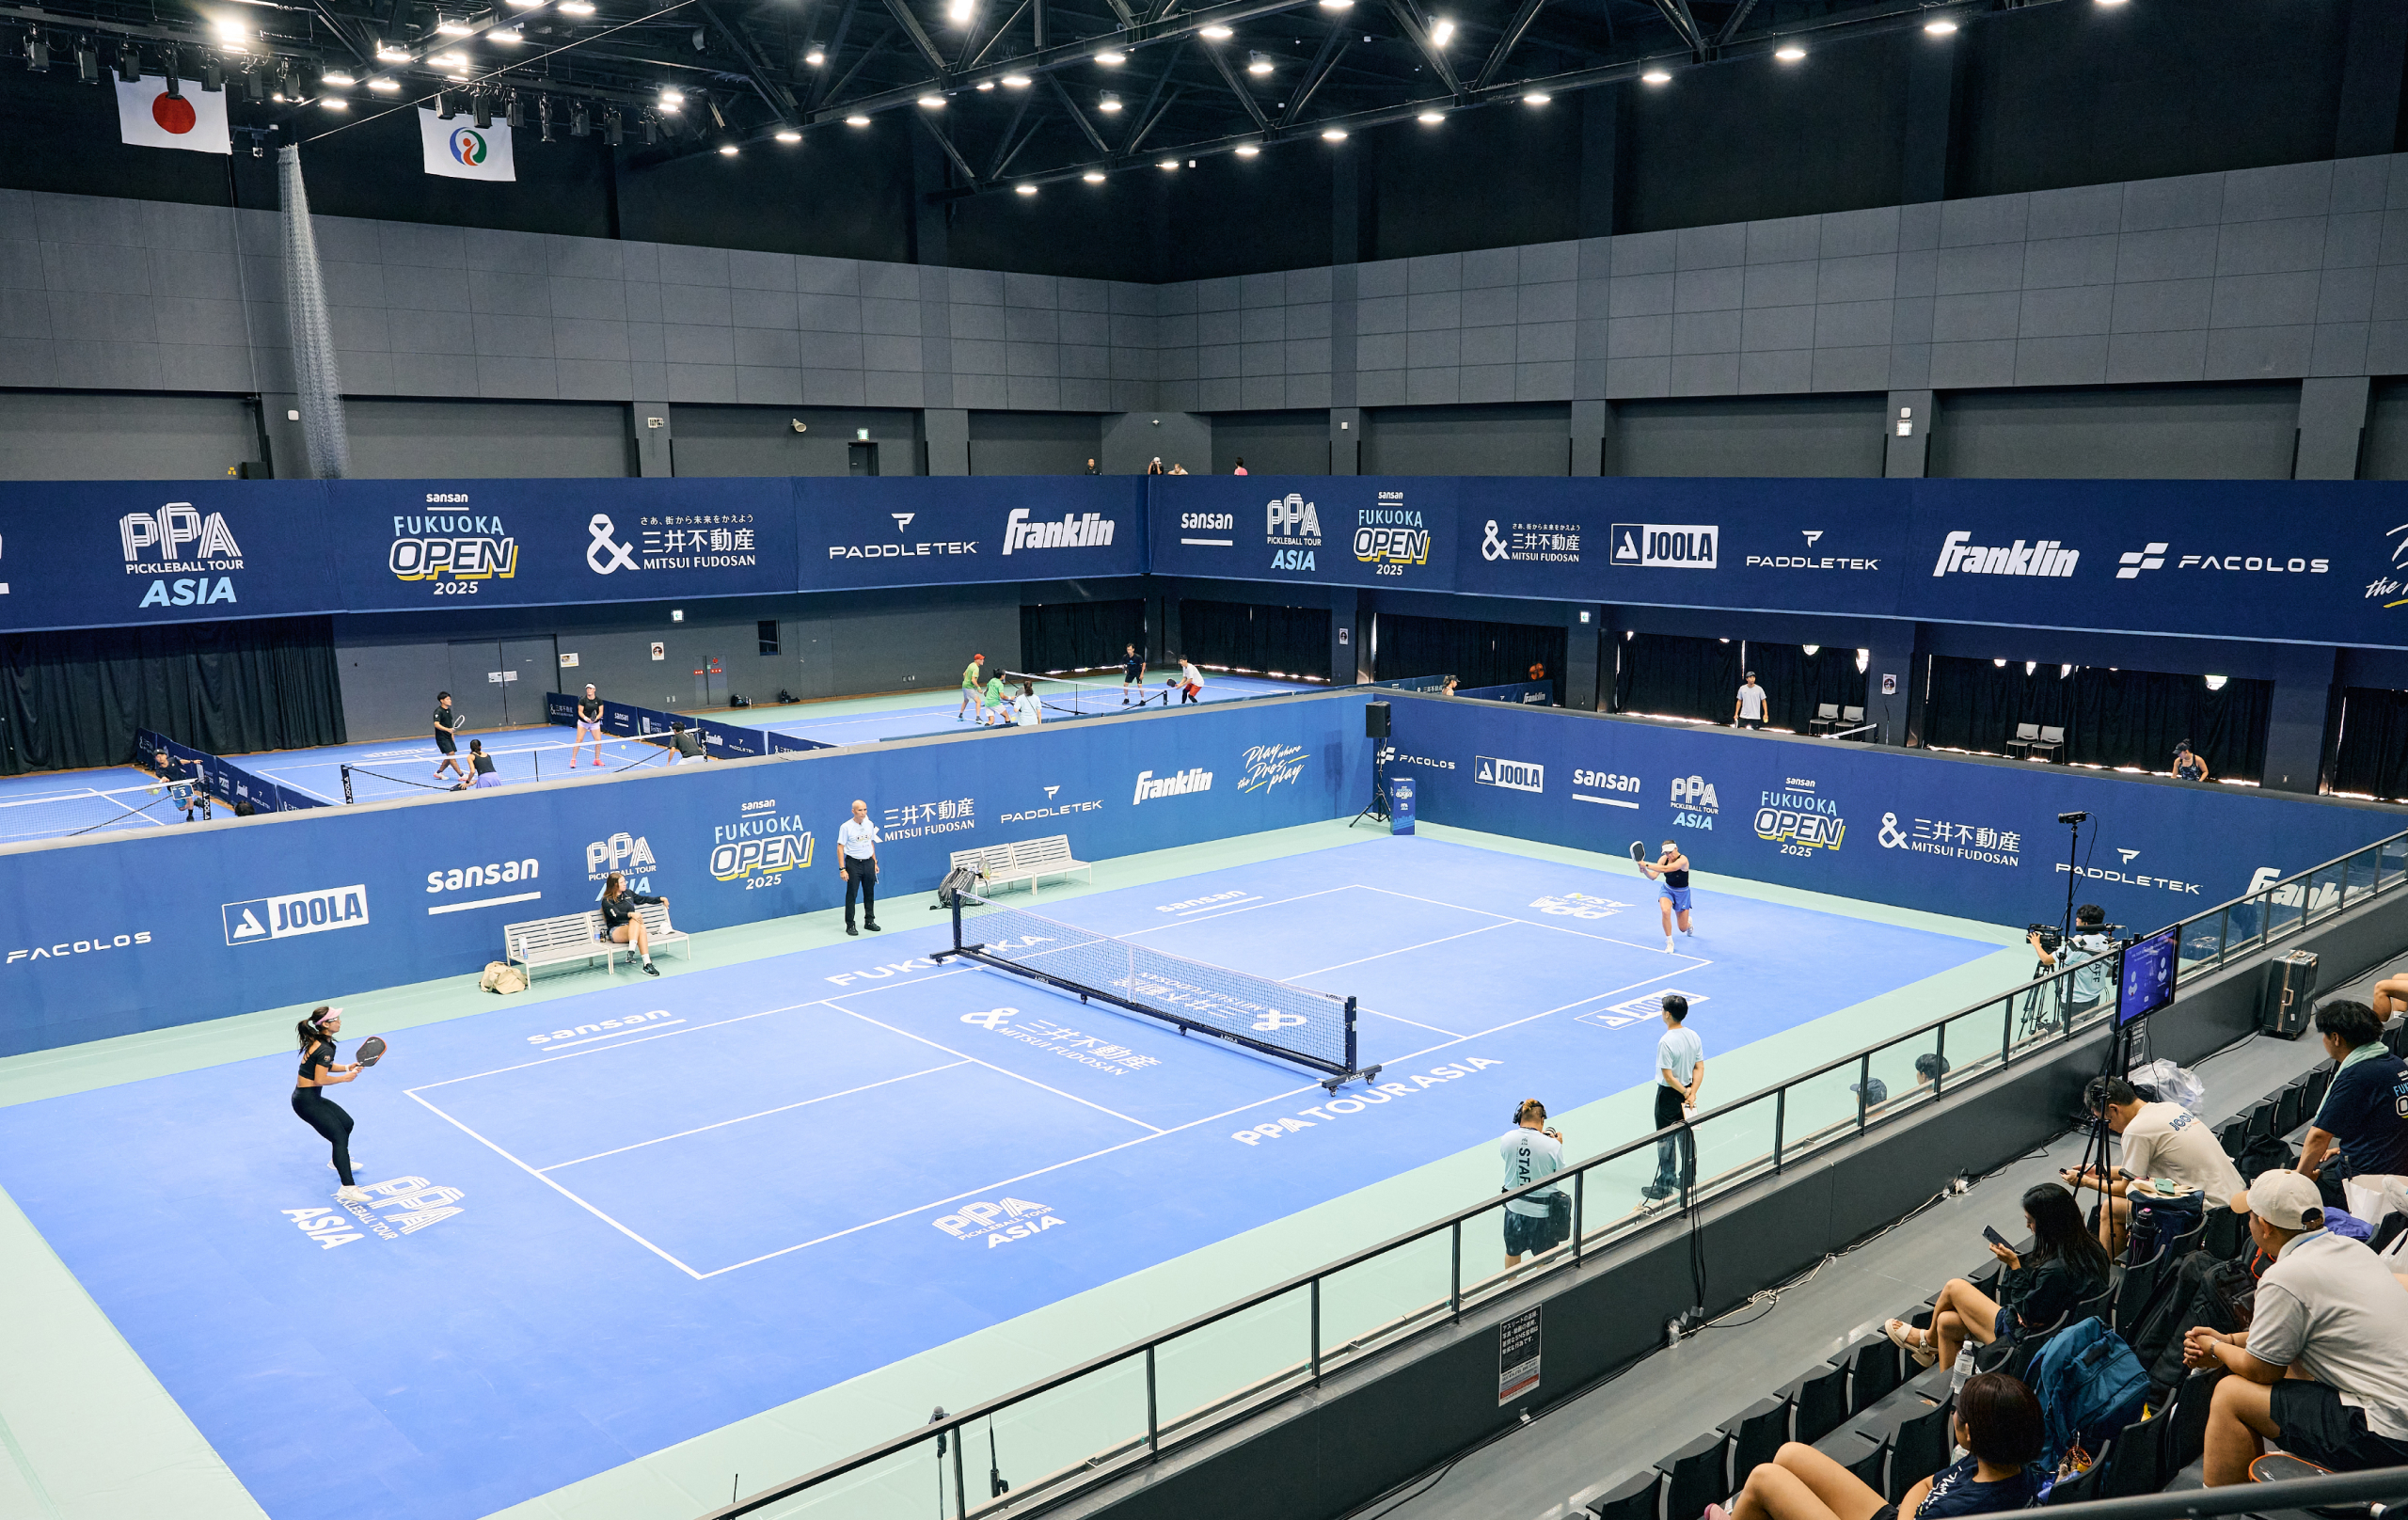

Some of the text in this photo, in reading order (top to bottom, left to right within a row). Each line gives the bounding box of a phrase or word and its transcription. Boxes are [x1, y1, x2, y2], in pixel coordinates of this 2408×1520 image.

[426, 493, 468, 503] sansan
[1378, 491, 1403, 500] sansan
[393, 515, 504, 536] FUKUOKA
[641, 515, 753, 526] さあ、街から未来をかえよう
[1180, 513, 1233, 530] sansan
[1267, 493, 1322, 536] PPA
[1358, 509, 1423, 529] FUKUOKA
[119, 502, 243, 562] PPA
[642, 528, 755, 554] 三井不動産
[1267, 537, 1322, 546] PICKLEBALL TOUR
[1512, 532, 1580, 551] 三井不動産
[389, 537, 517, 578] OPEN
[829, 541, 976, 560] PADDLETEK
[1354, 528, 1430, 564] OPEN
[1512, 551, 1579, 562] MITSUI FUDOSAN
[1645, 530, 1714, 562] JOOLA
[126, 560, 244, 575] PICKLEBALL TOUR
[643, 555, 755, 570] MITSUI FUDOSAN
[1271, 549, 1316, 571] ASIA
[1376, 564, 1402, 576] 2025
[1747, 556, 1878, 570] PADDLETEK
[2178, 555, 2330, 573] FACOLOS
[139, 577, 236, 608] ASIA
[434, 581, 478, 595] 2025
[2365, 577, 2402, 598] the
[1242, 743, 1302, 769] Play where
[1400, 754, 1455, 769] FACOLOS
[1237, 759, 1305, 794] the Pros play
[1498, 764, 1541, 788] JOOLA
[1573, 768, 1640, 794] sansan
[1785, 777, 1815, 788] sansan
[1671, 775, 1719, 807] PPA
[1761, 790, 1837, 816] FUKUOKA
[741, 799, 775, 812] sansan
[883, 798, 975, 829] 三井不動産
[1001, 800, 1101, 824] PADDLETEK
[1671, 801, 1719, 815] PICKLEBALL TOUR
[714, 815, 804, 845] FUKUOKA
[884, 819, 975, 842] MITSUI FUDOSAN
[1672, 812, 1713, 831] ASIA
[1753, 808, 1845, 850] OPEN
[1911, 816, 2020, 855] 三井不動産
[586, 832, 656, 873] PPA
[709, 831, 815, 879] OPEN
[1781, 844, 1813, 858] 2025
[1911, 841, 2019, 867] MITSUI FUDOSAN
[425, 858, 539, 894] sansan
[589, 865, 657, 881] PICKALL TOUR
[746, 873, 783, 891] 2025
[2055, 863, 2200, 895] PADDLETEK
[595, 877, 651, 901] IA
[1155, 891, 1247, 912] sansan
[277, 893, 362, 932] JOOLA
[6, 931, 151, 964] FACOLOS
[526, 1009, 672, 1044] sansan
[994, 1027, 1129, 1076] MITSUI FUDOSAN
[1015, 1019, 1163, 1070] 三井不動産
[1230, 1056, 1505, 1146] PPA TOUR ASIA
[2169, 1109, 2194, 1132] JOOL
[1519, 1148, 1531, 1186] STAF
[356, 1176, 466, 1235] PPA
[932, 1196, 1047, 1237] PPA
[280, 1207, 365, 1250] ASIA
[369, 1222, 399, 1241] TOUR
[958, 1206, 1054, 1241] PICKLEBALL TOUR
[989, 1215, 1067, 1249] ASIA
